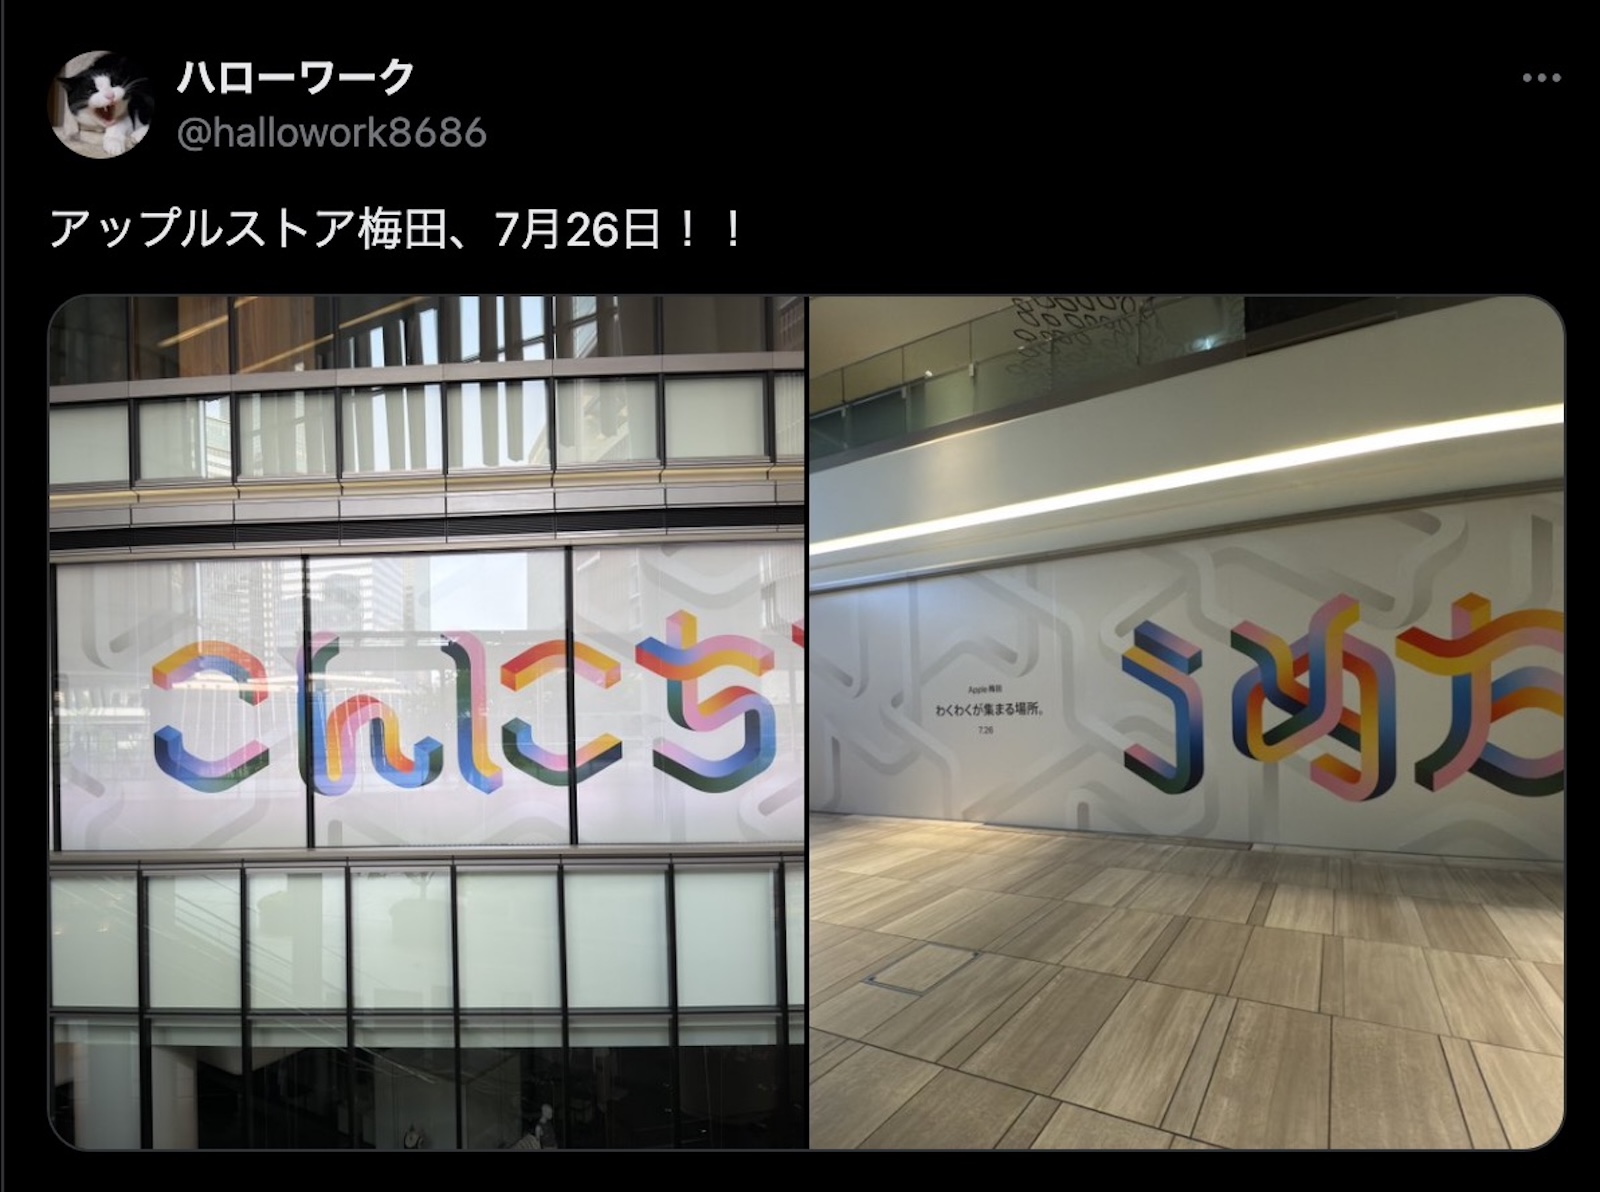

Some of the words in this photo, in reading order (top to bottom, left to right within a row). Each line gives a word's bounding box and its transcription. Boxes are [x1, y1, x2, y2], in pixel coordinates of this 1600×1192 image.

[968, 685, 987, 694] Apple
[936, 701, 1043, 717] わくわくが集まる場所。
